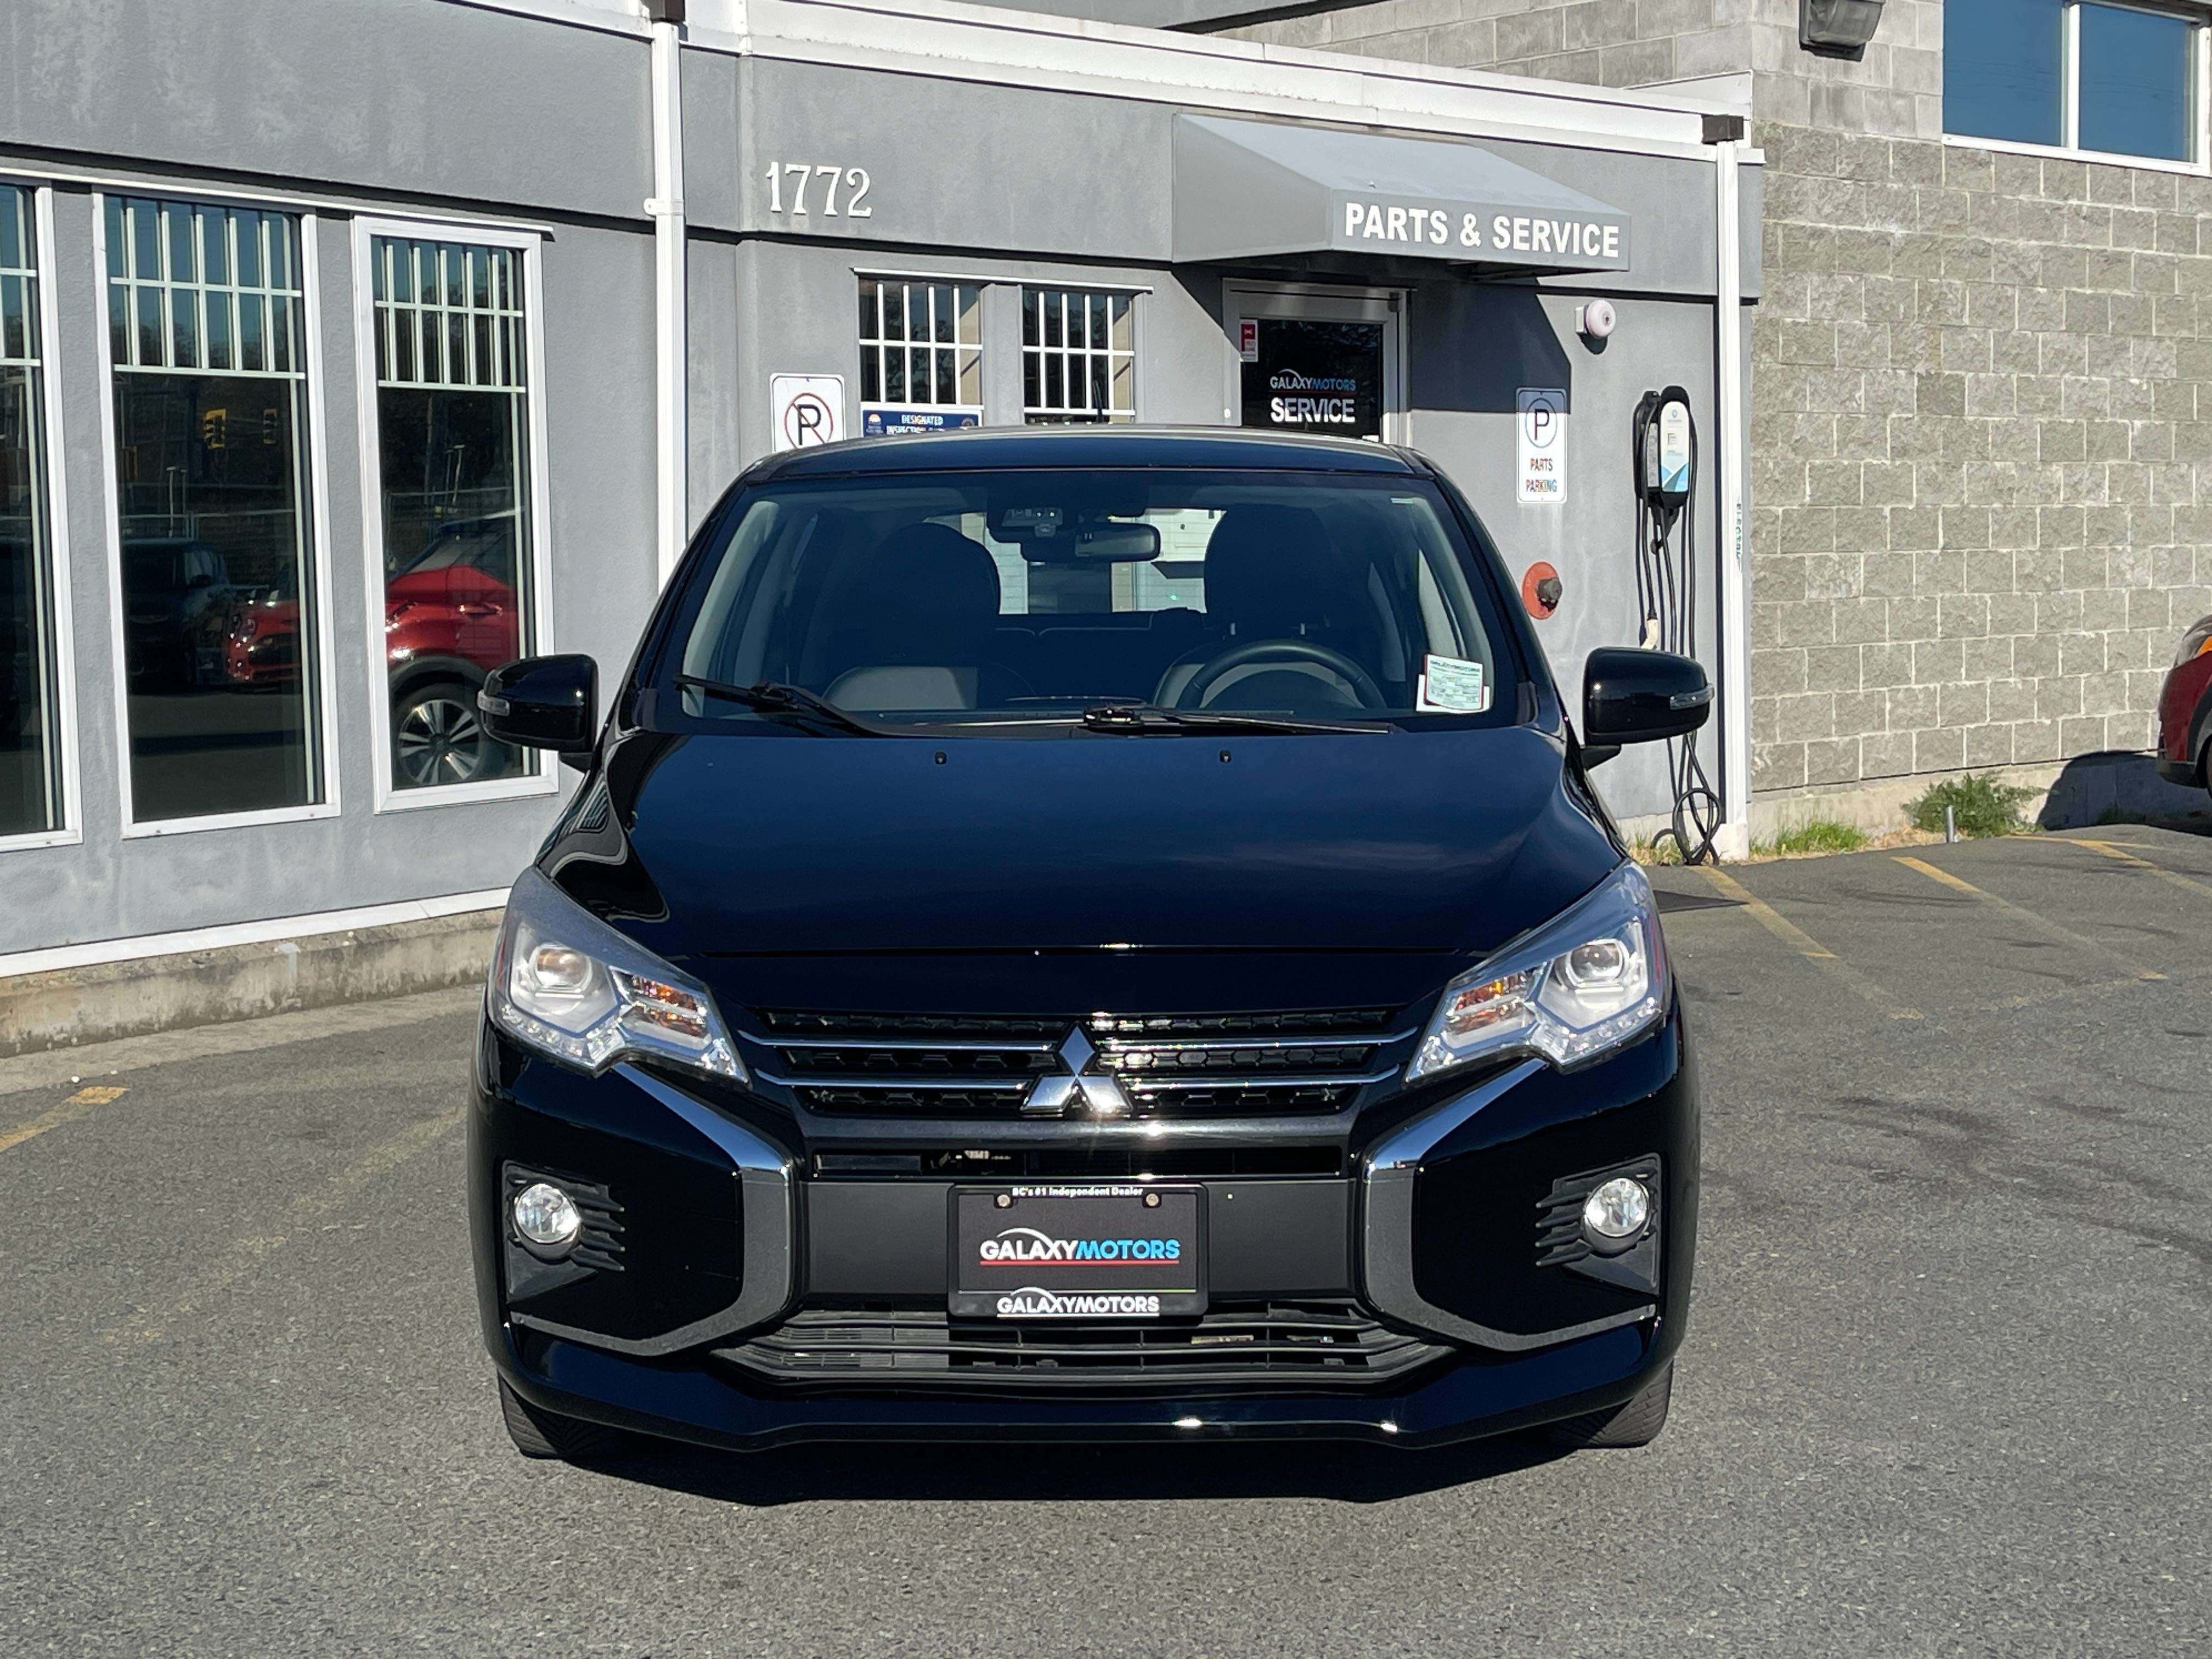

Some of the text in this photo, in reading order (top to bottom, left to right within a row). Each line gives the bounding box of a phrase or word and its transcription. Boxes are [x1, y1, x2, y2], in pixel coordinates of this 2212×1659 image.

[766, 162, 872, 217] 1772
[1345, 202, 1620, 258] PARTS & SERVICE
[901, 415, 944, 425] DESIGNATED
[1270, 397, 1356, 423] SERVICE
[1534, 408, 1550, 441] P
[1530, 458, 1553, 472] PARTS
[1525, 478, 1558, 493] PARKING
[1049, 1187, 1109, 1198] Independent
[1111, 1187, 1143, 1196] Dealer
